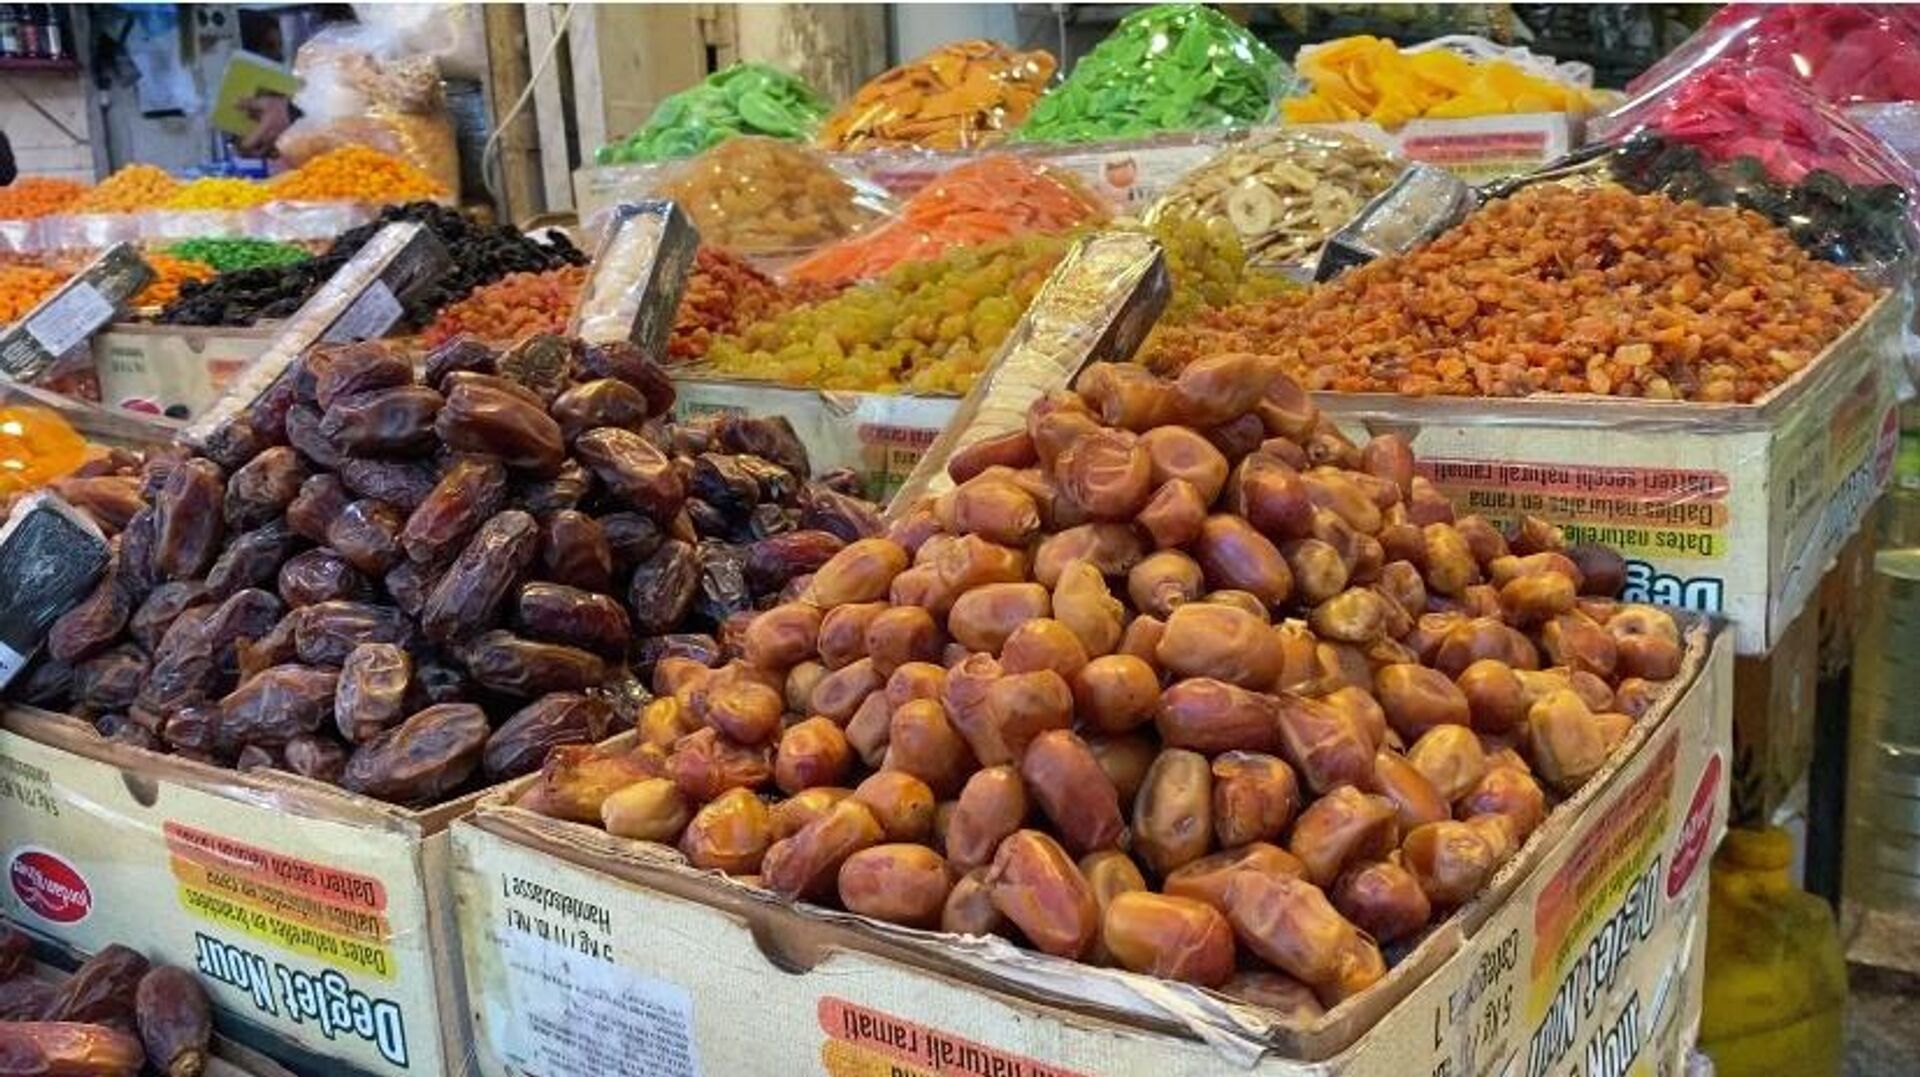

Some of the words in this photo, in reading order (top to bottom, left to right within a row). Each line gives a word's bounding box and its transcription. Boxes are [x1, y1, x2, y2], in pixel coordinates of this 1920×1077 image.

[1434, 463, 1494, 480] ramati
[1500, 465, 1568, 487] naturali
[1469, 490, 1515, 510] rama
[1523, 494, 1544, 510] en
[1655, 530, 1712, 556] Dates
[512, 877, 612, 936] Handelsclasse
[341, 938, 387, 976] Dates
[195, 932, 278, 1017] Nour
[274, 962, 409, 1068] Deglet
[842, 1009, 917, 1052] ramati
